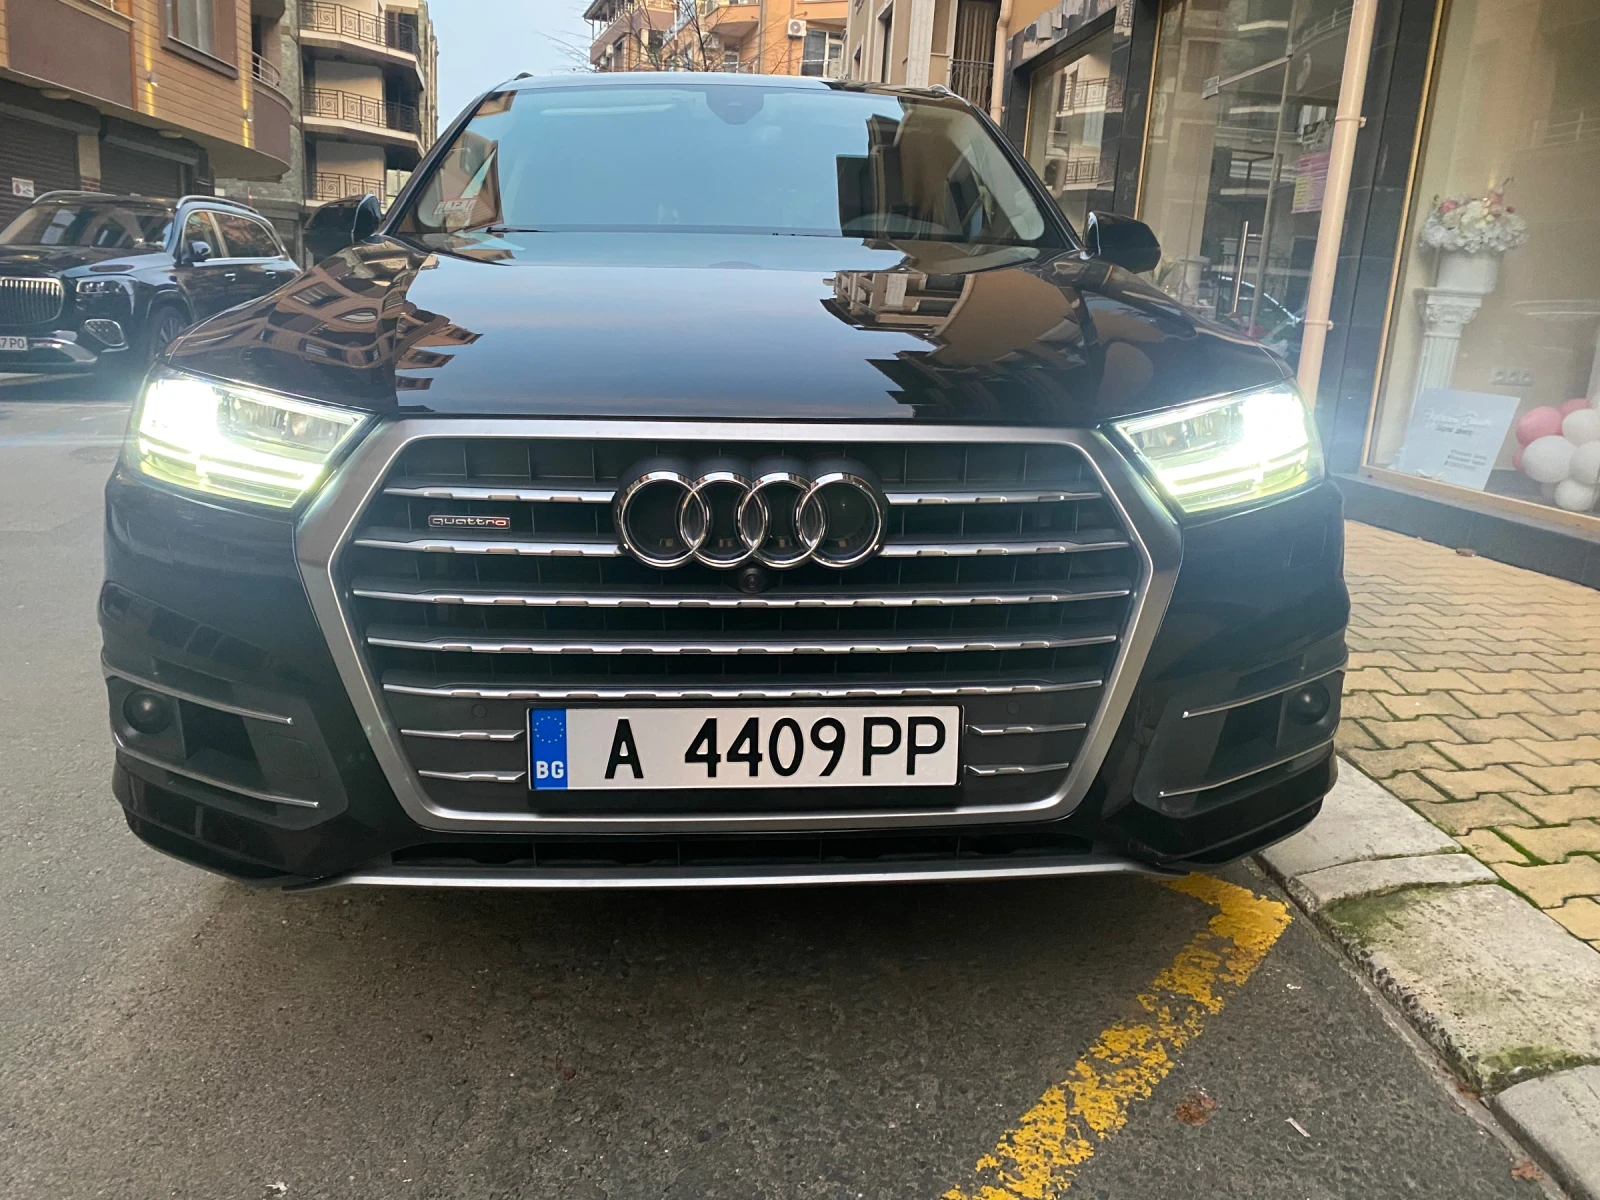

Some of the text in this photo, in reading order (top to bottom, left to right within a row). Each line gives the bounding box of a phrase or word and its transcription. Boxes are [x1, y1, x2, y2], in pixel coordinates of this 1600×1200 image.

[432, 517, 507, 526] quattro
[604, 716, 946, 779] A 4409 PP
[536, 760, 565, 779] BG
